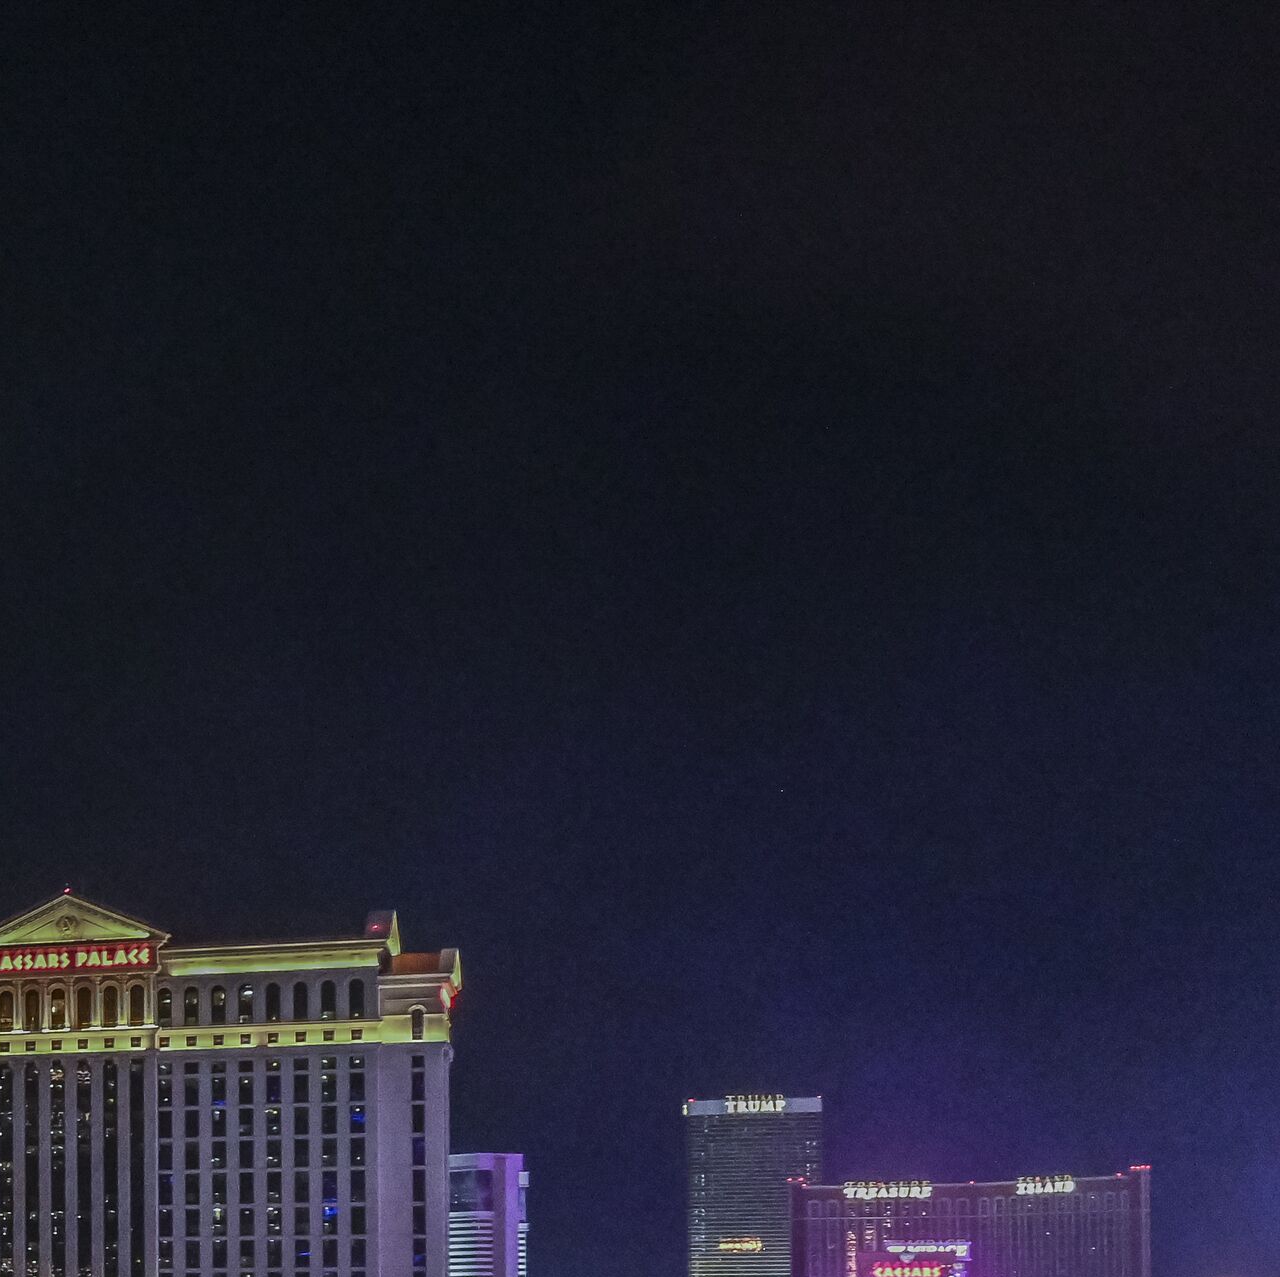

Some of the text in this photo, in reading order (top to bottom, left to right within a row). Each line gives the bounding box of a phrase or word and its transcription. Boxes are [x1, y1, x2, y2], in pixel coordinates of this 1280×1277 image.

[75, 948, 150, 967] PALACE
[724, 1100, 786, 1113] TRUMP
[842, 1181, 1074, 1200] TREASURE ISLAND
[873, 1267, 941, 1277] CAESARS
